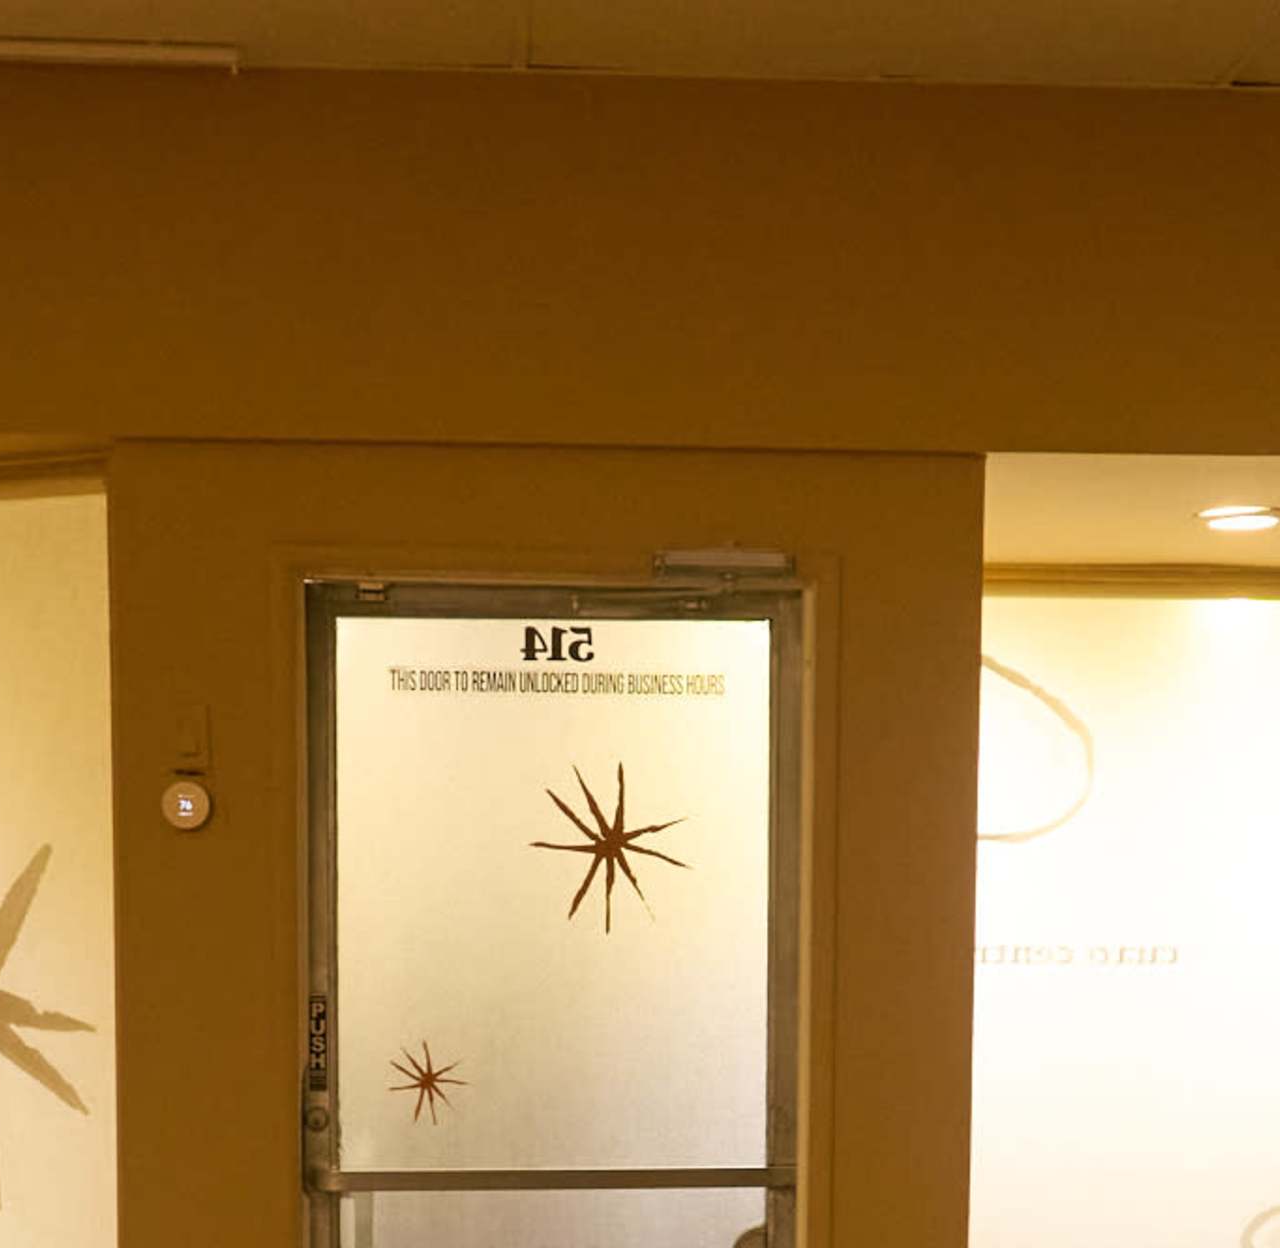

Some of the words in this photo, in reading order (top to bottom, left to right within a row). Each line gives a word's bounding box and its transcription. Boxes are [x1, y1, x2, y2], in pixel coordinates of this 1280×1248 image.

[390, 669, 417, 691] THIS
[419, 669, 451, 692] DOOR
[454, 670, 469, 692] TO
[472, 670, 517, 693] REMAIN
[520, 671, 580, 694] UNLOCKED
[582, 672, 625, 695] DURING
[627, 673, 685, 696] BUSINESS
[686, 674, 726, 696] HOURS
[311, 1002, 326, 1069] PUSH
